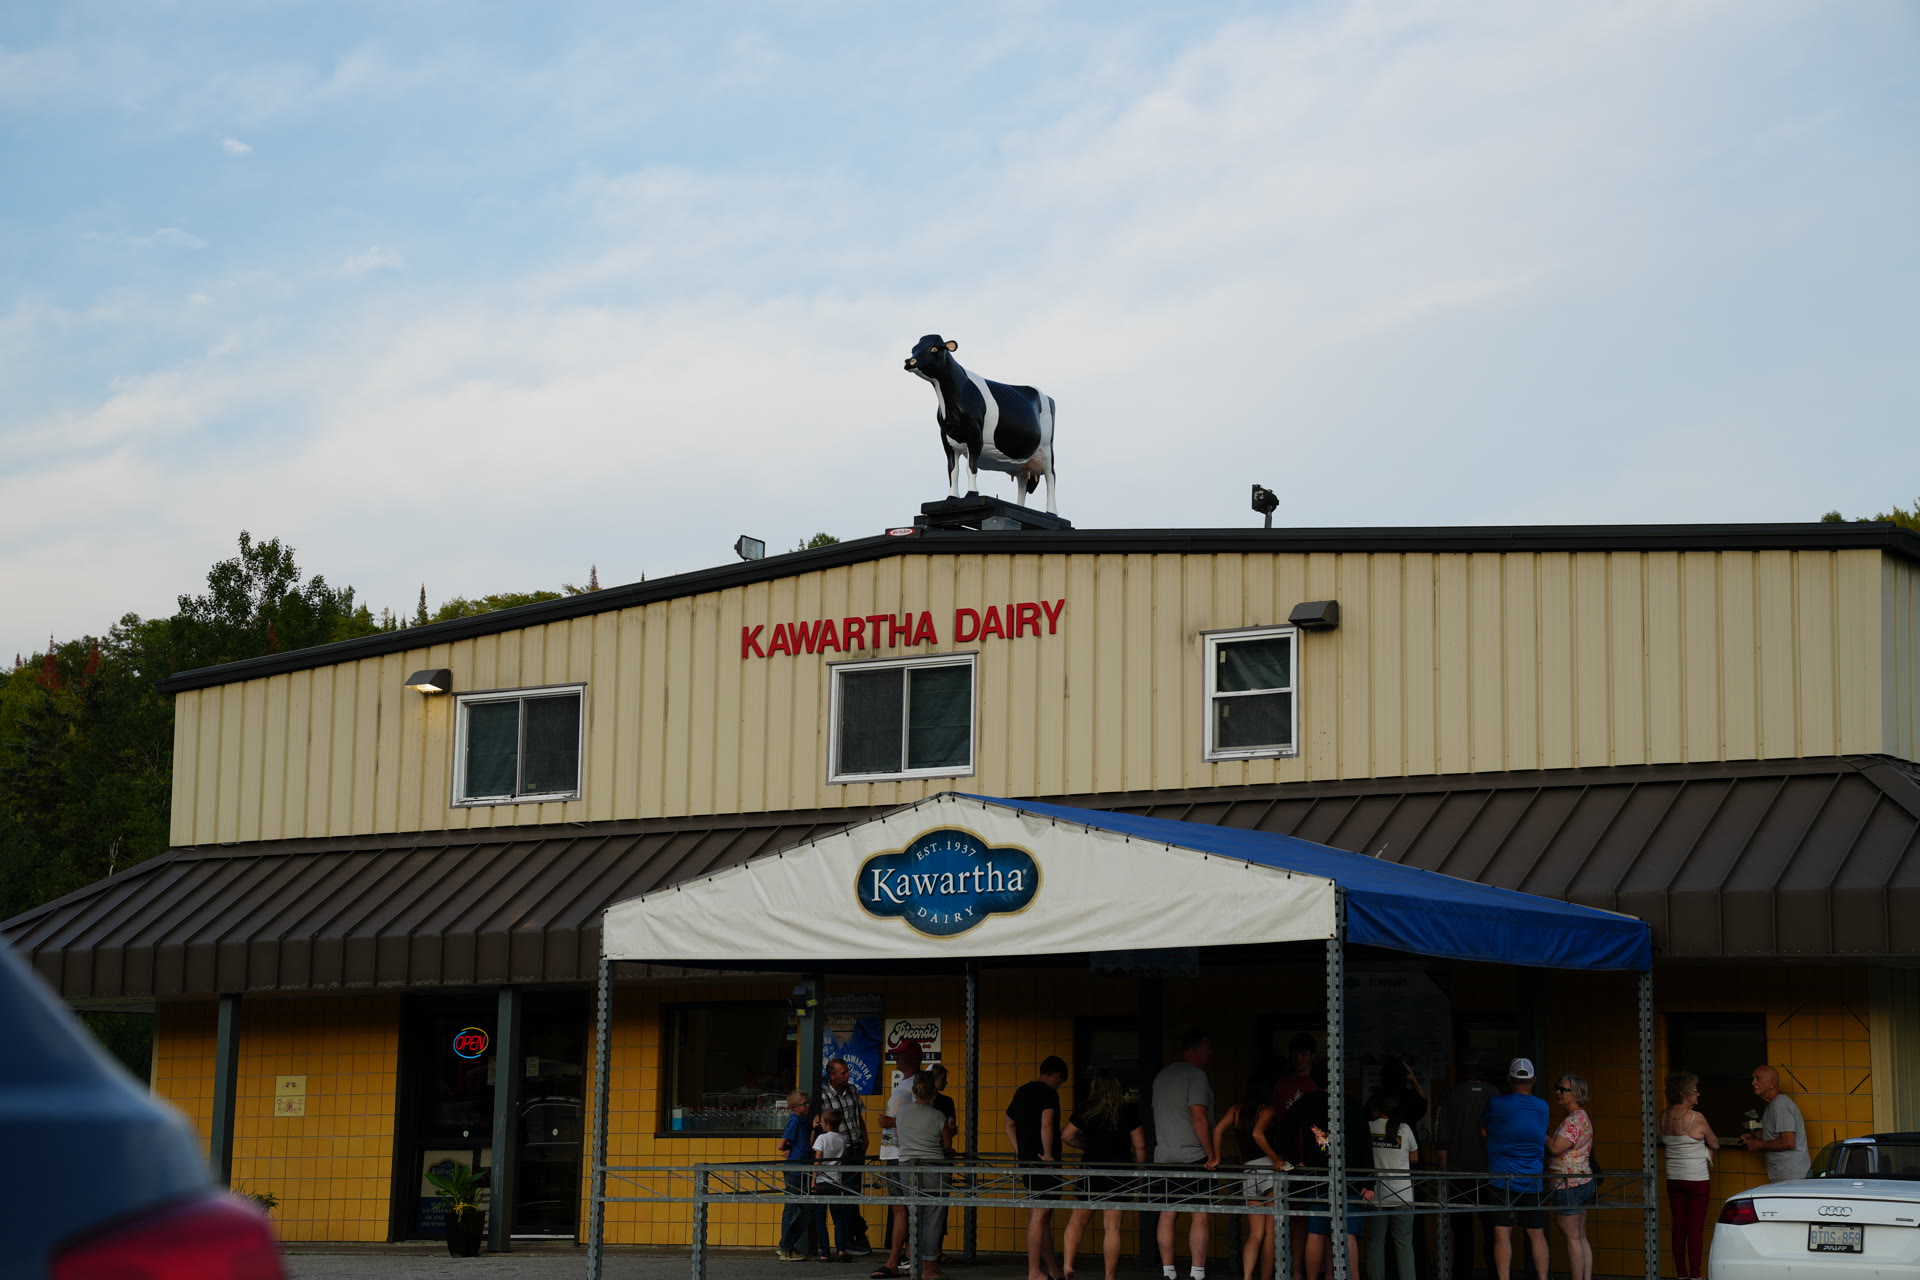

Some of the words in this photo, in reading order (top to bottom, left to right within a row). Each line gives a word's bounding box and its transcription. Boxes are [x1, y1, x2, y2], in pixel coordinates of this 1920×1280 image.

[741, 611, 938, 660] KAWARTHA
[955, 599, 1065, 643] DAIRY
[916, 842, 942, 861] EST.
[946, 841, 977, 857] 1937
[871, 861, 1024, 904] Kawartha
[916, 905, 975, 924] DAIRY
[456, 1035, 486, 1050] OPEN
[889, 1021, 938, 1046] Picard's
[843, 1054, 872, 1080] KAWARTHA
[1842, 1232, 1861, 1246] 859
